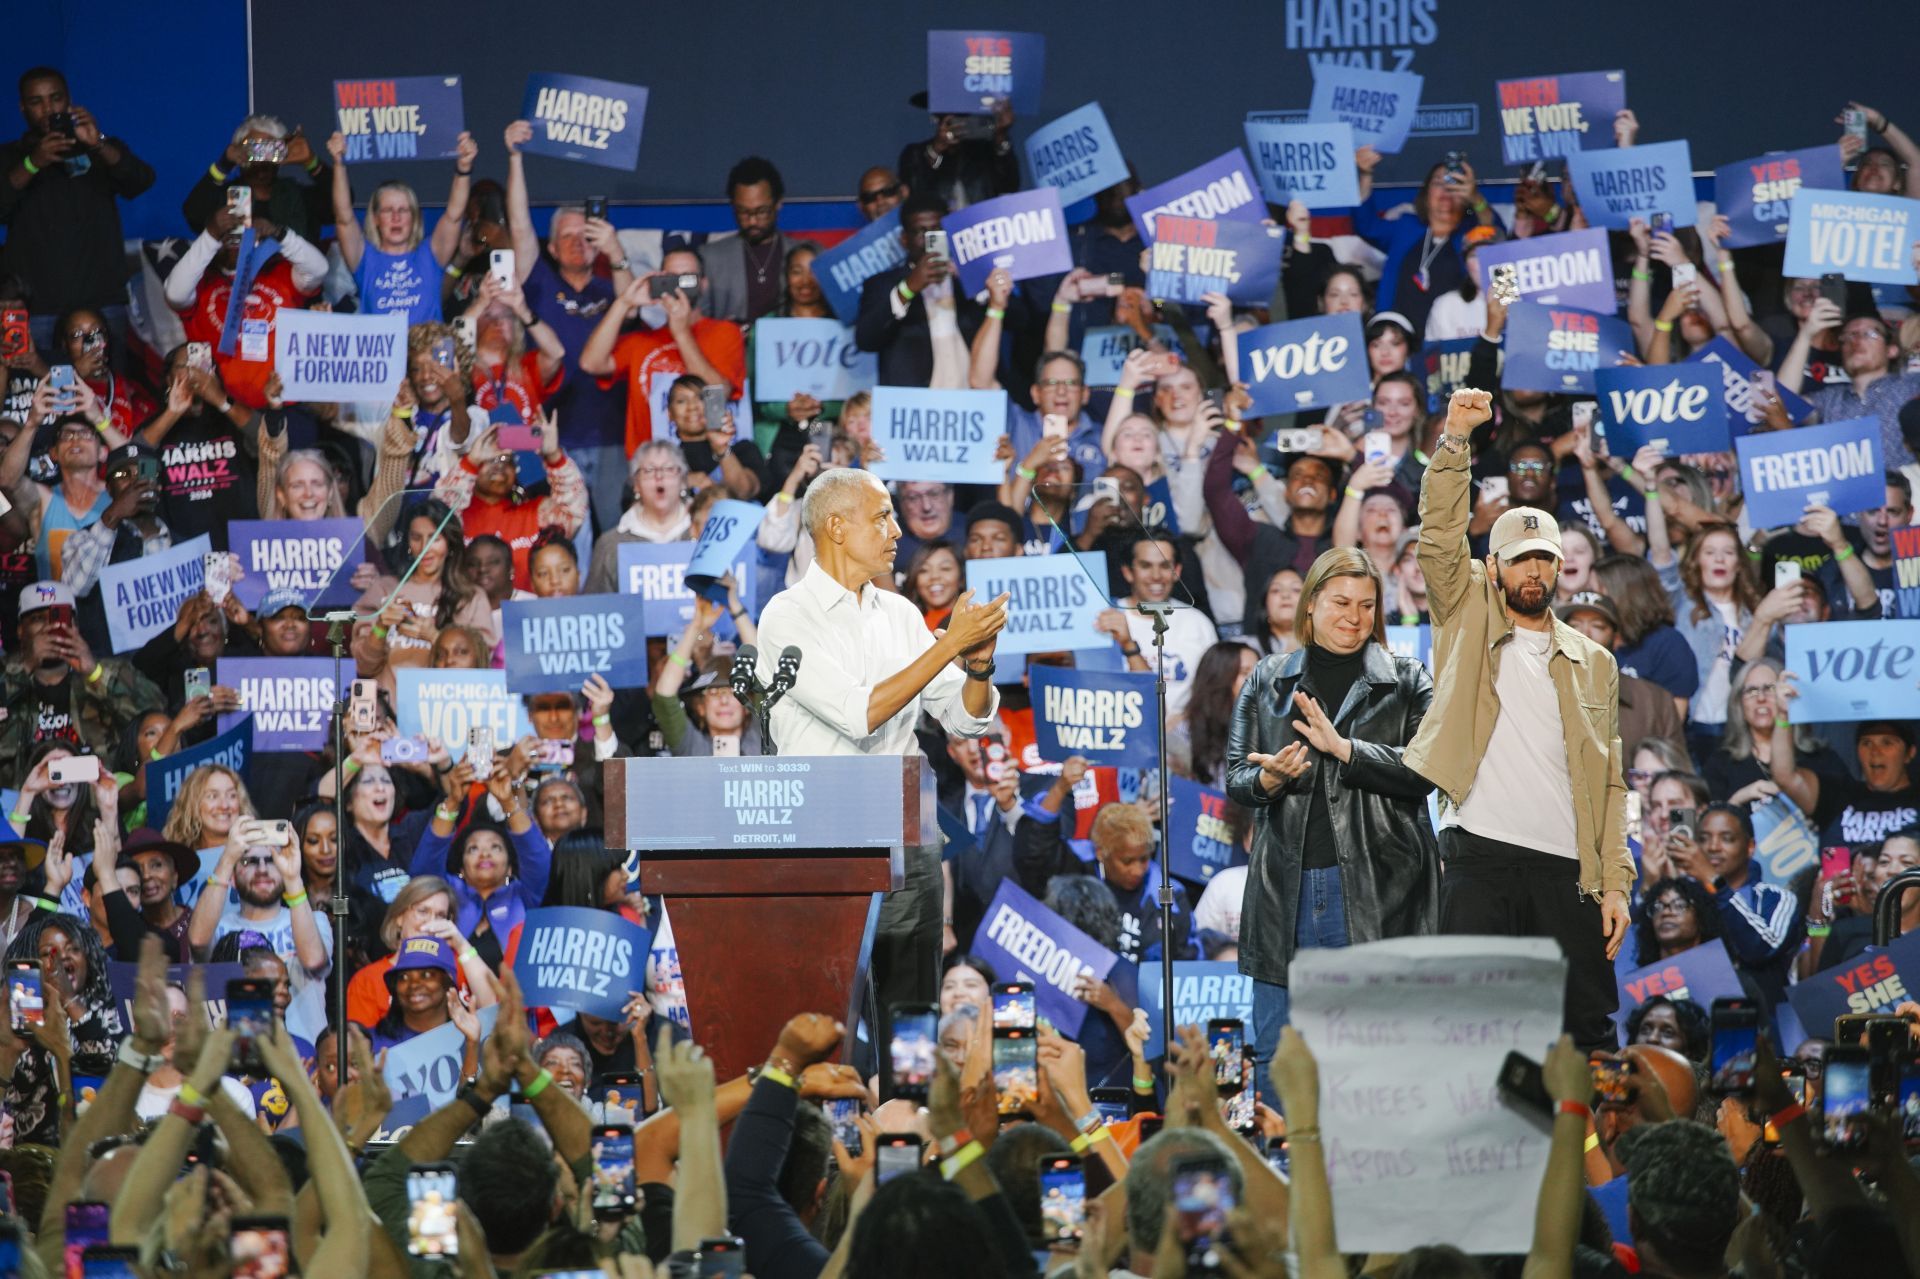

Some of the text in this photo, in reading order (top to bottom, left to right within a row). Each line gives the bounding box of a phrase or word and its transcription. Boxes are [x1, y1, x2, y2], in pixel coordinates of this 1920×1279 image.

[1285, 0, 1438, 49] HARRIS
[964, 38, 1013, 57] YES
[964, 56, 1012, 76] SHE
[336, 80, 396, 107] WHEN
[963, 75, 1013, 93] CAN
[1498, 78, 1559, 109] WHEN
[534, 87, 628, 134] HARRIS
[1330, 86, 1399, 120] HARRIS
[1501, 102, 1590, 136] WE VOTE,
[338, 105, 427, 136] WE VOTE,
[546, 121, 612, 150] WALZ
[1338, 114, 1385, 135] WALZ
[344, 132, 417, 161] WE WIN
[1032, 125, 1100, 179] HARRIS
[1258, 141, 1337, 173] HARRIS
[1503, 130, 1582, 163] WE WIN
[1047, 158, 1098, 188] WALZ
[1272, 173, 1328, 192] WALZ
[1594, 165, 1667, 198] HARRIS
[1751, 159, 1802, 184] YES
[1606, 195, 1657, 214] WALZ
[1752, 178, 1802, 203] SHE
[1753, 201, 1790, 222] CA
[1810, 203, 1909, 226] MICHIGAN
[952, 208, 1056, 265] FREEDOM
[1156, 214, 1218, 248] WHEN
[1810, 219, 1906, 271] VOTE!
[830, 224, 908, 293] HARRI
[1153, 241, 1242, 284] WE VOTE,
[1488, 248, 1603, 296] FEEDOM
[1150, 270, 1184, 299] WE
[1549, 310, 1599, 334] YES
[287, 333, 396, 358] A NEW WAY
[775, 335, 862, 372] vote
[1250, 330, 1350, 384] vote
[1548, 331, 1599, 353] SHE
[295, 359, 388, 385] FORWARD
[1545, 350, 1599, 371] CAN
[1609, 378, 1709, 426] vote
[890, 407, 984, 442] HARRIS
[903, 443, 969, 463] WALZ
[1751, 438, 1874, 492] FREEDOM
[167, 458, 230, 483] WALZ
[700, 515, 738, 542] RIS
[1522, 515, 1539, 532] D
[251, 538, 343, 572] HARRIS
[117, 582, 130, 607] A
[133, 568, 175, 603] NEW
[267, 569, 330, 590] WALZ
[629, 562, 746, 601] FREEM
[987, 573, 1087, 612] HARRIS
[127, 584, 205, 631] FORW
[1005, 612, 1074, 633] WALZ
[522, 612, 625, 653] HARRIS
[539, 650, 612, 675] WALZ
[1806, 637, 1915, 684] vote
[240, 677, 335, 712] HARRIS
[418, 683, 520, 700] MICHIGA
[1044, 685, 1143, 729] HARRIS
[256, 711, 322, 731] WALZ
[418, 701, 517, 751] VOTE!
[1056, 725, 1126, 750] WALZ
[165, 738, 244, 802] HRIS
[719, 763, 810, 773] Text WIN to 30330
[724, 780, 804, 807] HARRIS
[1200, 792, 1226, 819] YE
[736, 809, 792, 825] WALZ
[1196, 813, 1234, 846] SHE
[733, 834, 796, 844] DETROIT, MI
[1192, 834, 1233, 866] CAN
[1843, 826, 1886, 842] WAL
[528, 926, 632, 978] HARRIS
[987, 903, 1096, 999] FREEDOM
[537, 965, 612, 997] WALZ
[1625, 966, 1685, 1007] YES
[1835, 954, 1896, 998] YES
[1158, 975, 1253, 1010] HARRI
[1847, 974, 1906, 1014] SHE
[1328, 1072, 1502, 1117] KNEES WEA
[1326, 1136, 1527, 1185] ARMS HEAVY
